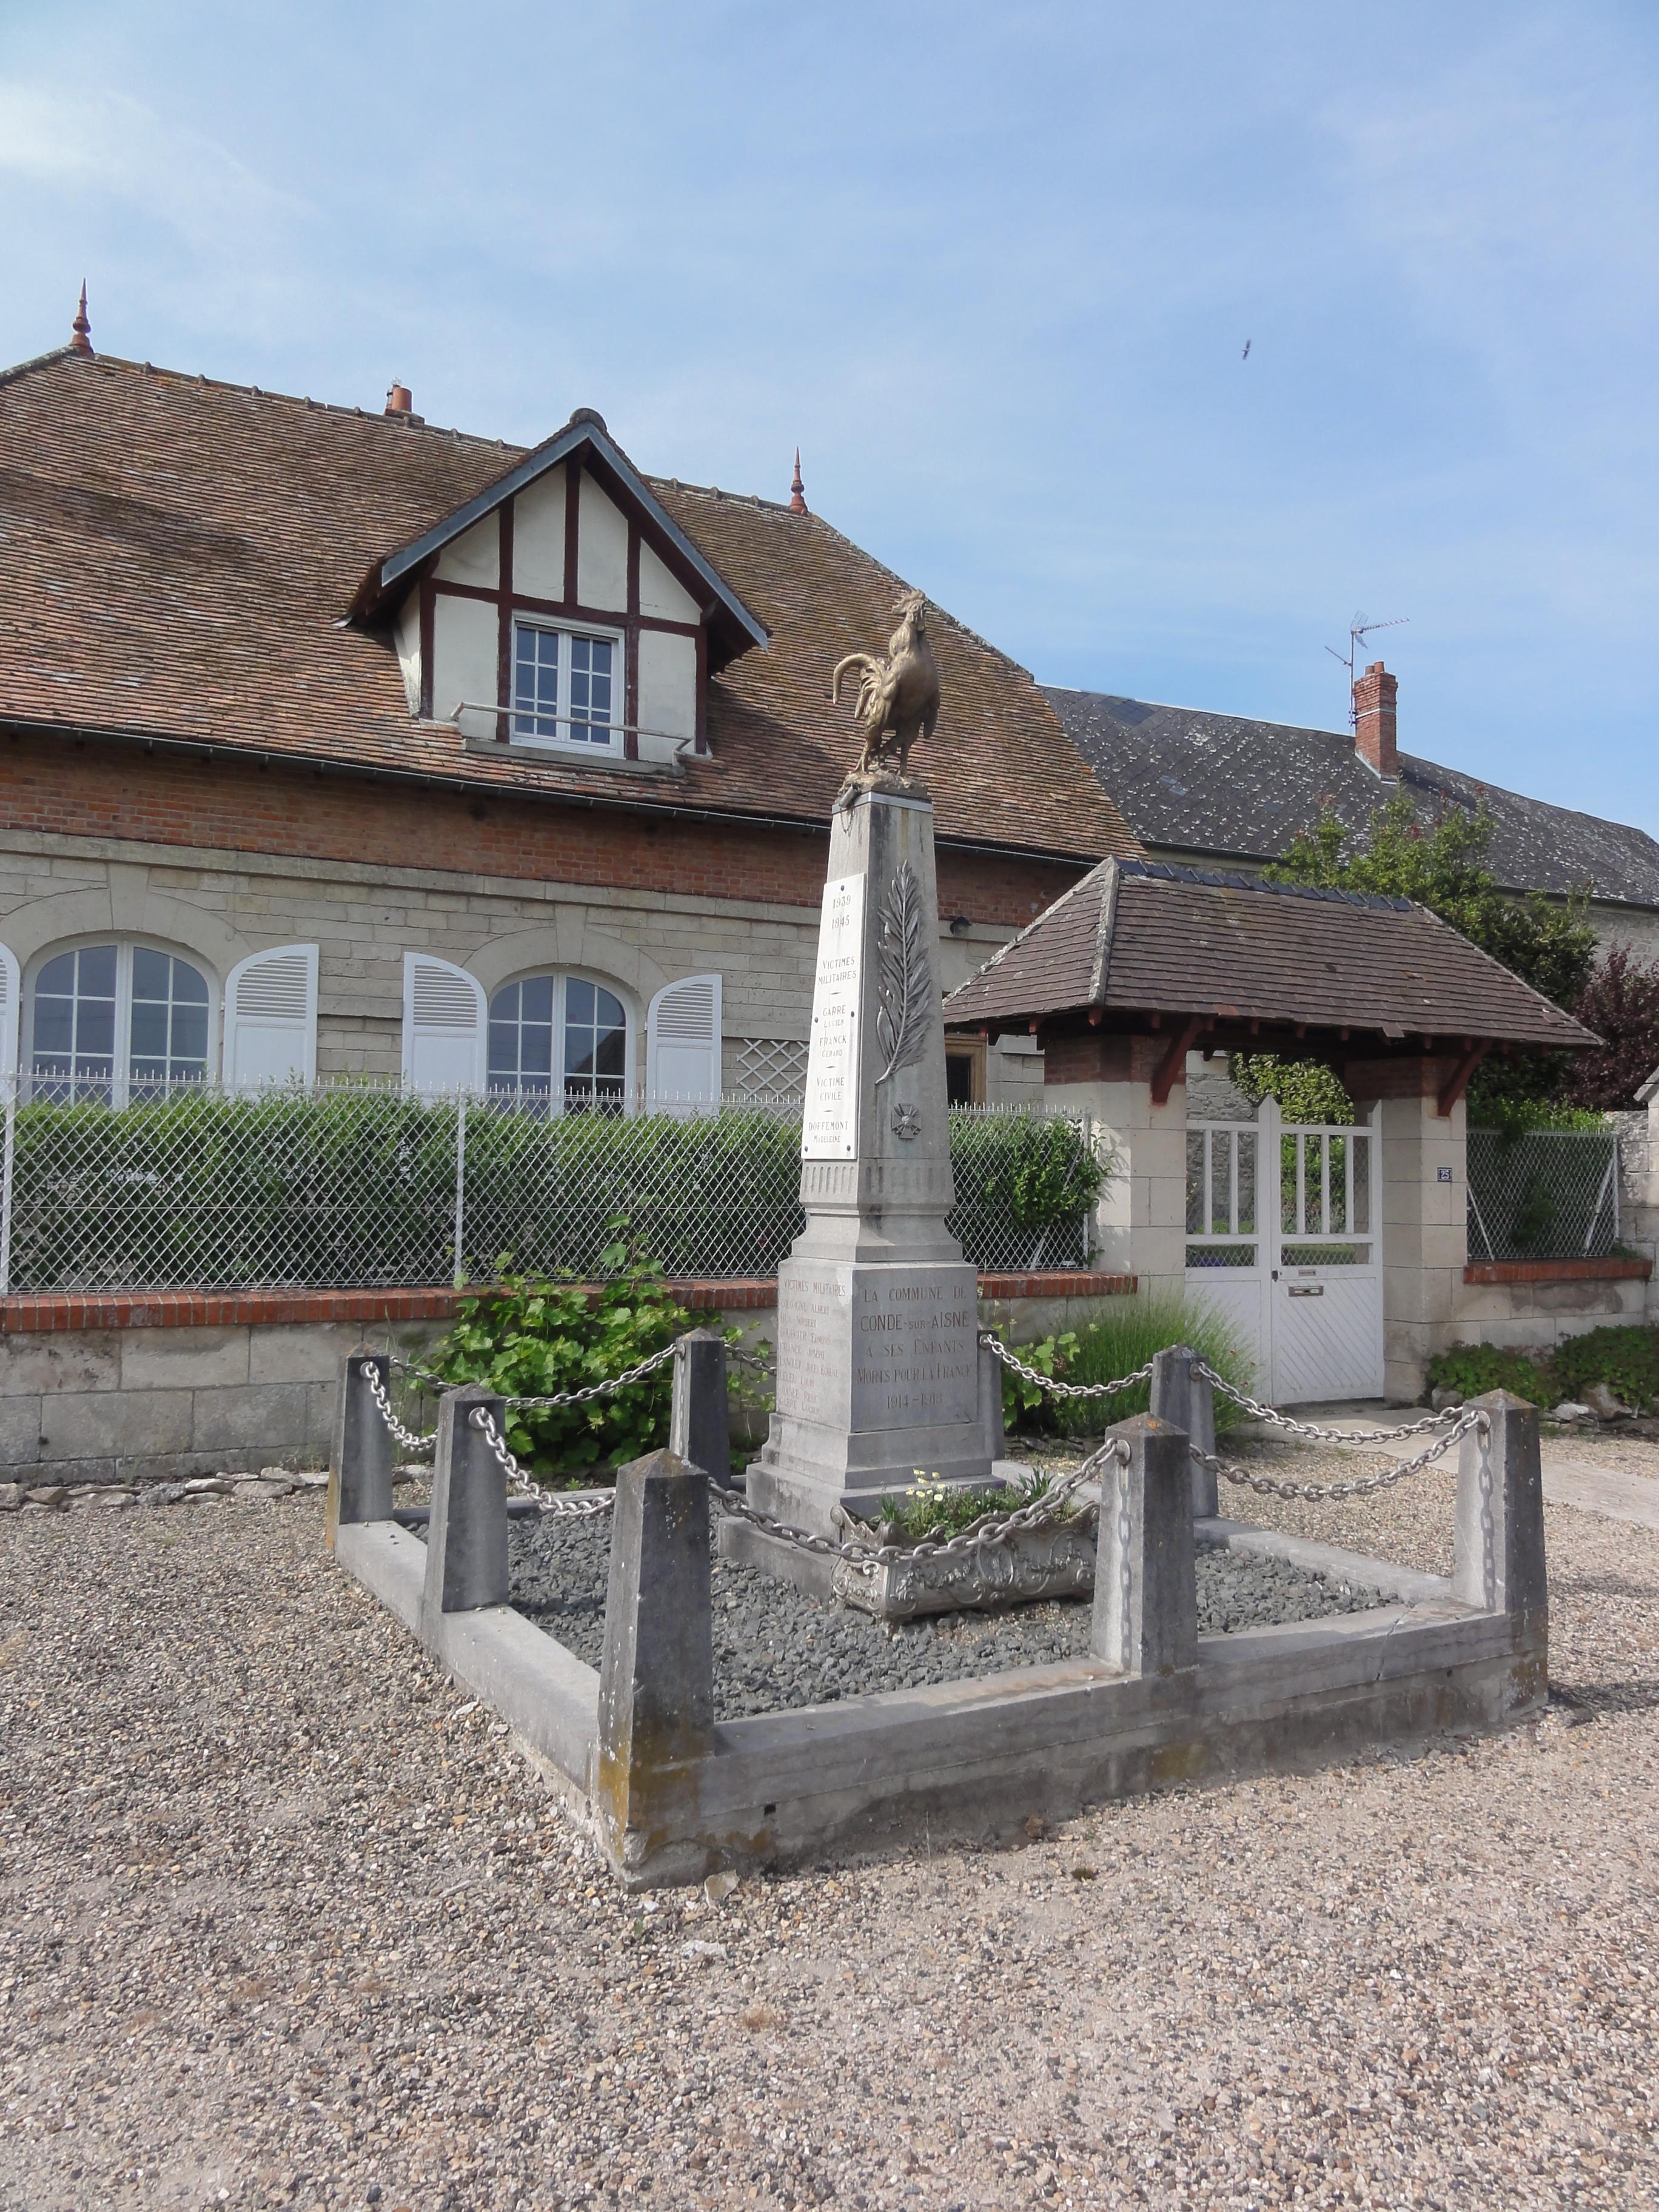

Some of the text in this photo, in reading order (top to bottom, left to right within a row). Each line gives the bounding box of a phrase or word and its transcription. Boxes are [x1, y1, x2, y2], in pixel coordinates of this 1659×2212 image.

[833, 895, 851, 909] 1939
[832, 915, 850, 930] 1945
[823, 956, 854, 970] VICTIMES
[818, 970, 856, 985] MILITAIRES
[823, 1005, 846, 1017] GARRE
[824, 1019, 844, 1028] LUCIEN
[819, 1034, 846, 1047] FRANCK
[817, 1077, 845, 1087] VICTIME
[820, 1091, 842, 1101] CIVILE
[808, 1121, 848, 1131] DOFFEMONT
[1441, 1170, 1449, 1179] 25
[784, 1278, 809, 1292] VICTIMES
[813, 1281, 846, 1296] MILITAIRES
[864, 1285, 967, 1302] LA COMMUNE DE
[883, 1343, 904, 1356] SES
[914, 1339, 965, 1355] ENFANTS
[857, 1362, 971, 1385] MORTS POUR LA FRANCE
